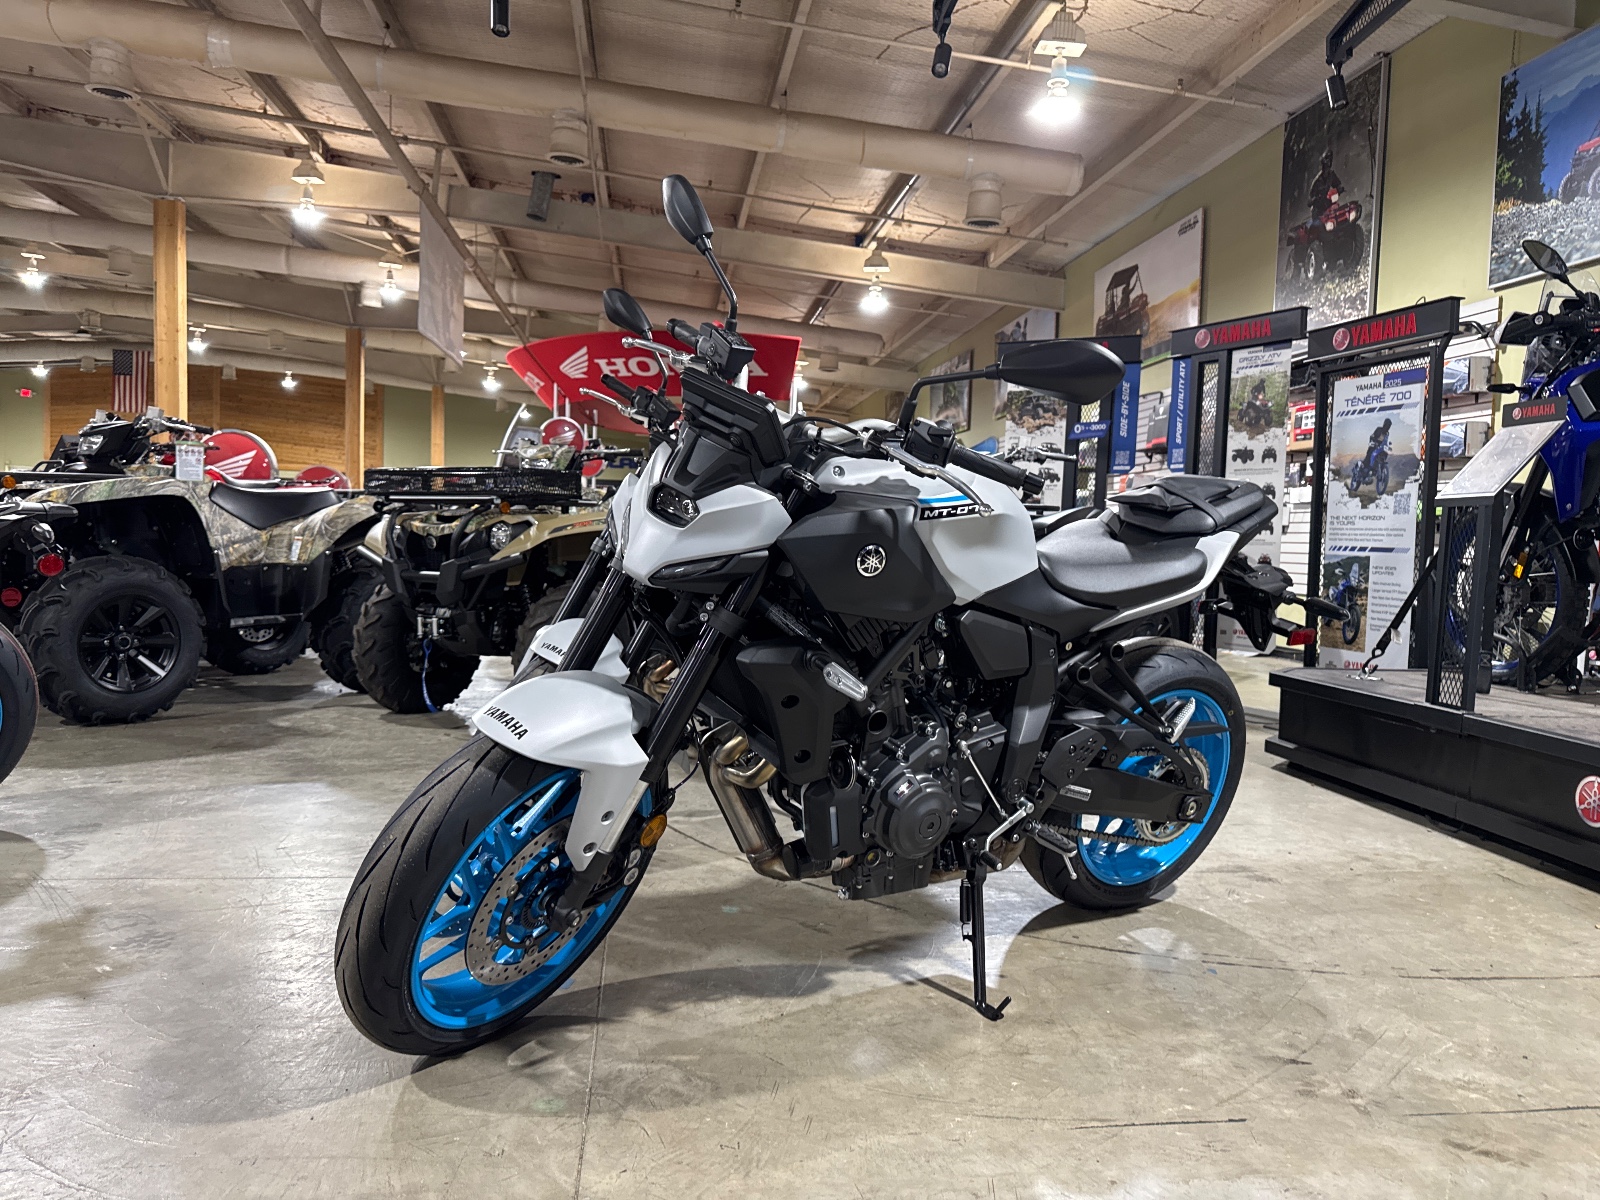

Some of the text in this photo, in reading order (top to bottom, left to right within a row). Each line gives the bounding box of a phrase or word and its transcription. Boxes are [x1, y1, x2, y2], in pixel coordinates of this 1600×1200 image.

[1211, 318, 1272, 346] YAMAHA
[1351, 312, 1417, 347] YAMAHA
[1238, 354, 1266, 364] GRIZZLY
[1177, 377, 1185, 410] UTILITY
[1355, 378, 1402, 392] YAMAHA 2025
[1344, 390, 1412, 408] TÉNÉRÉ 700
[1119, 380, 1131, 438] SIDE-BY-SIDE
[1176, 409, 1184, 418] /
[1522, 403, 1556, 418] YAMAHA
[1175, 416, 1183, 445] SPORT
[923, 504, 980, 518] MT-07
[541, 642, 567, 657] YAMA
[483, 705, 529, 740] YAMAHA
